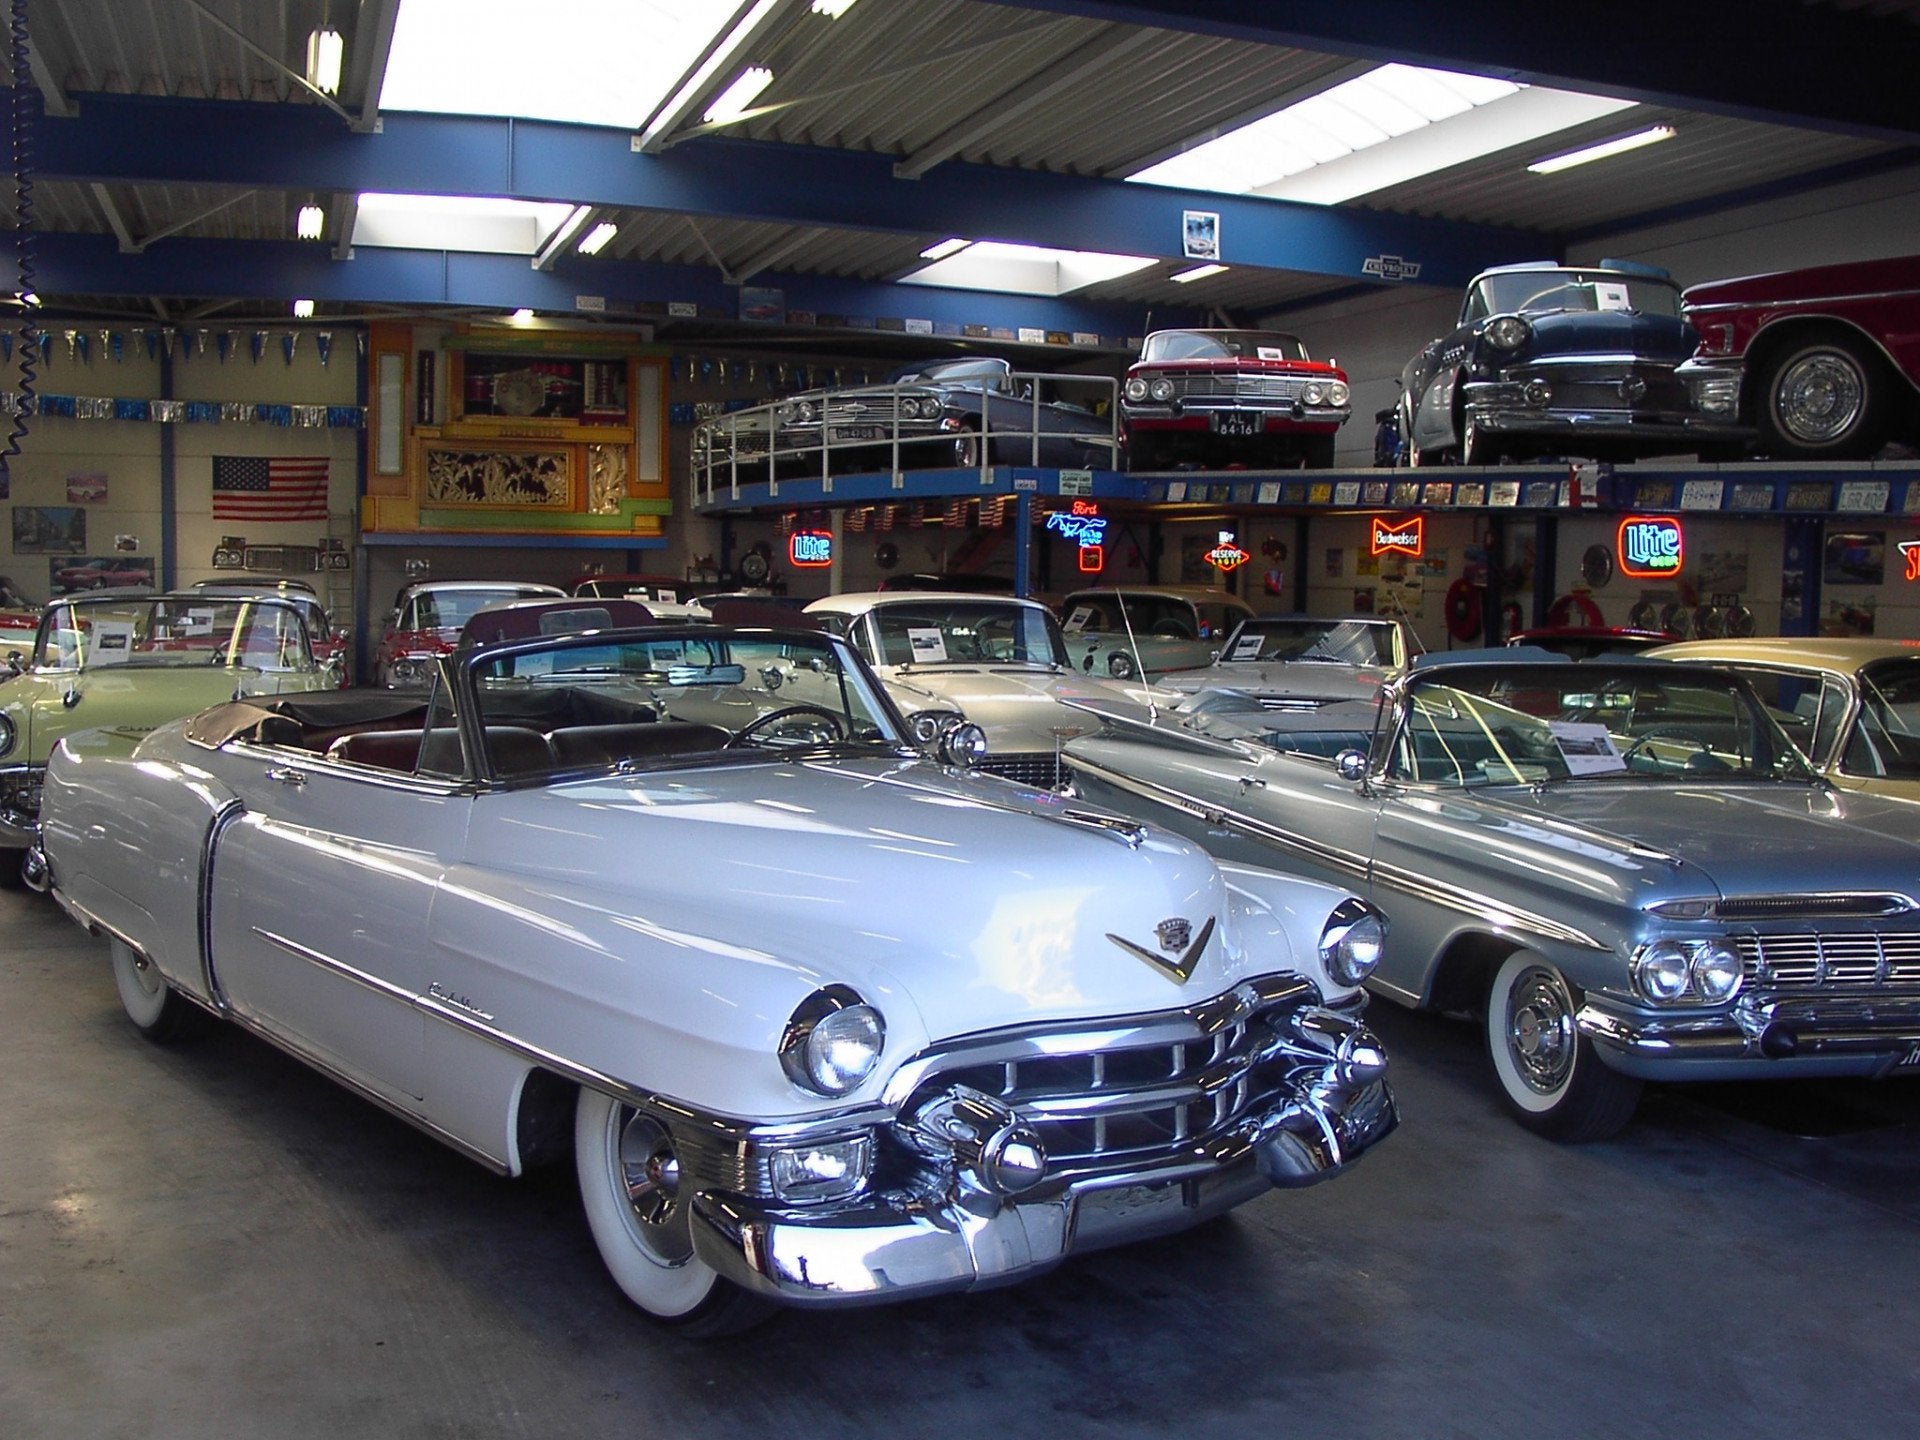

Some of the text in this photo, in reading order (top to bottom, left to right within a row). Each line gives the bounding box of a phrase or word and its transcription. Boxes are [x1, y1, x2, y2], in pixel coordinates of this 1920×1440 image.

[1229, 414, 1245, 425] AL
[1072, 500, 1098, 515] Ford
[1376, 530, 1419, 545] Budweiser
[1626, 523, 1680, 564] Lite
[794, 535, 830, 561] Lite
